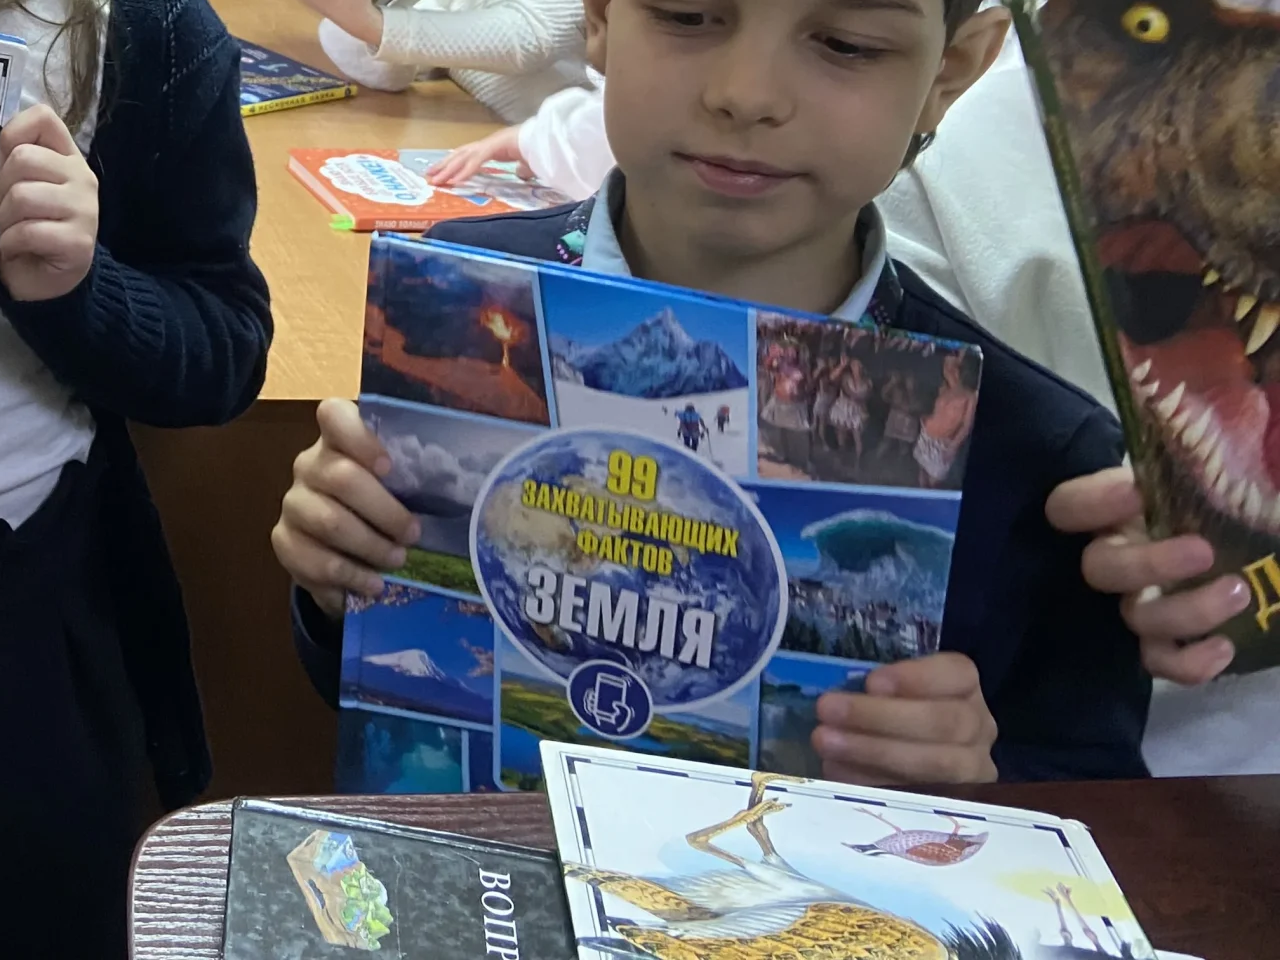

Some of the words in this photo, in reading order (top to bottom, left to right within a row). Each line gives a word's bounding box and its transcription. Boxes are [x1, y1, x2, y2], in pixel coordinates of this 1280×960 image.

[607, 449, 658, 502] 99
[522, 478, 740, 558] ЗАХВАТЫВАЮЩИХ
[577, 528, 674, 576] ФАКТОВ
[524, 565, 716, 669] ЗЕМЛЯ
